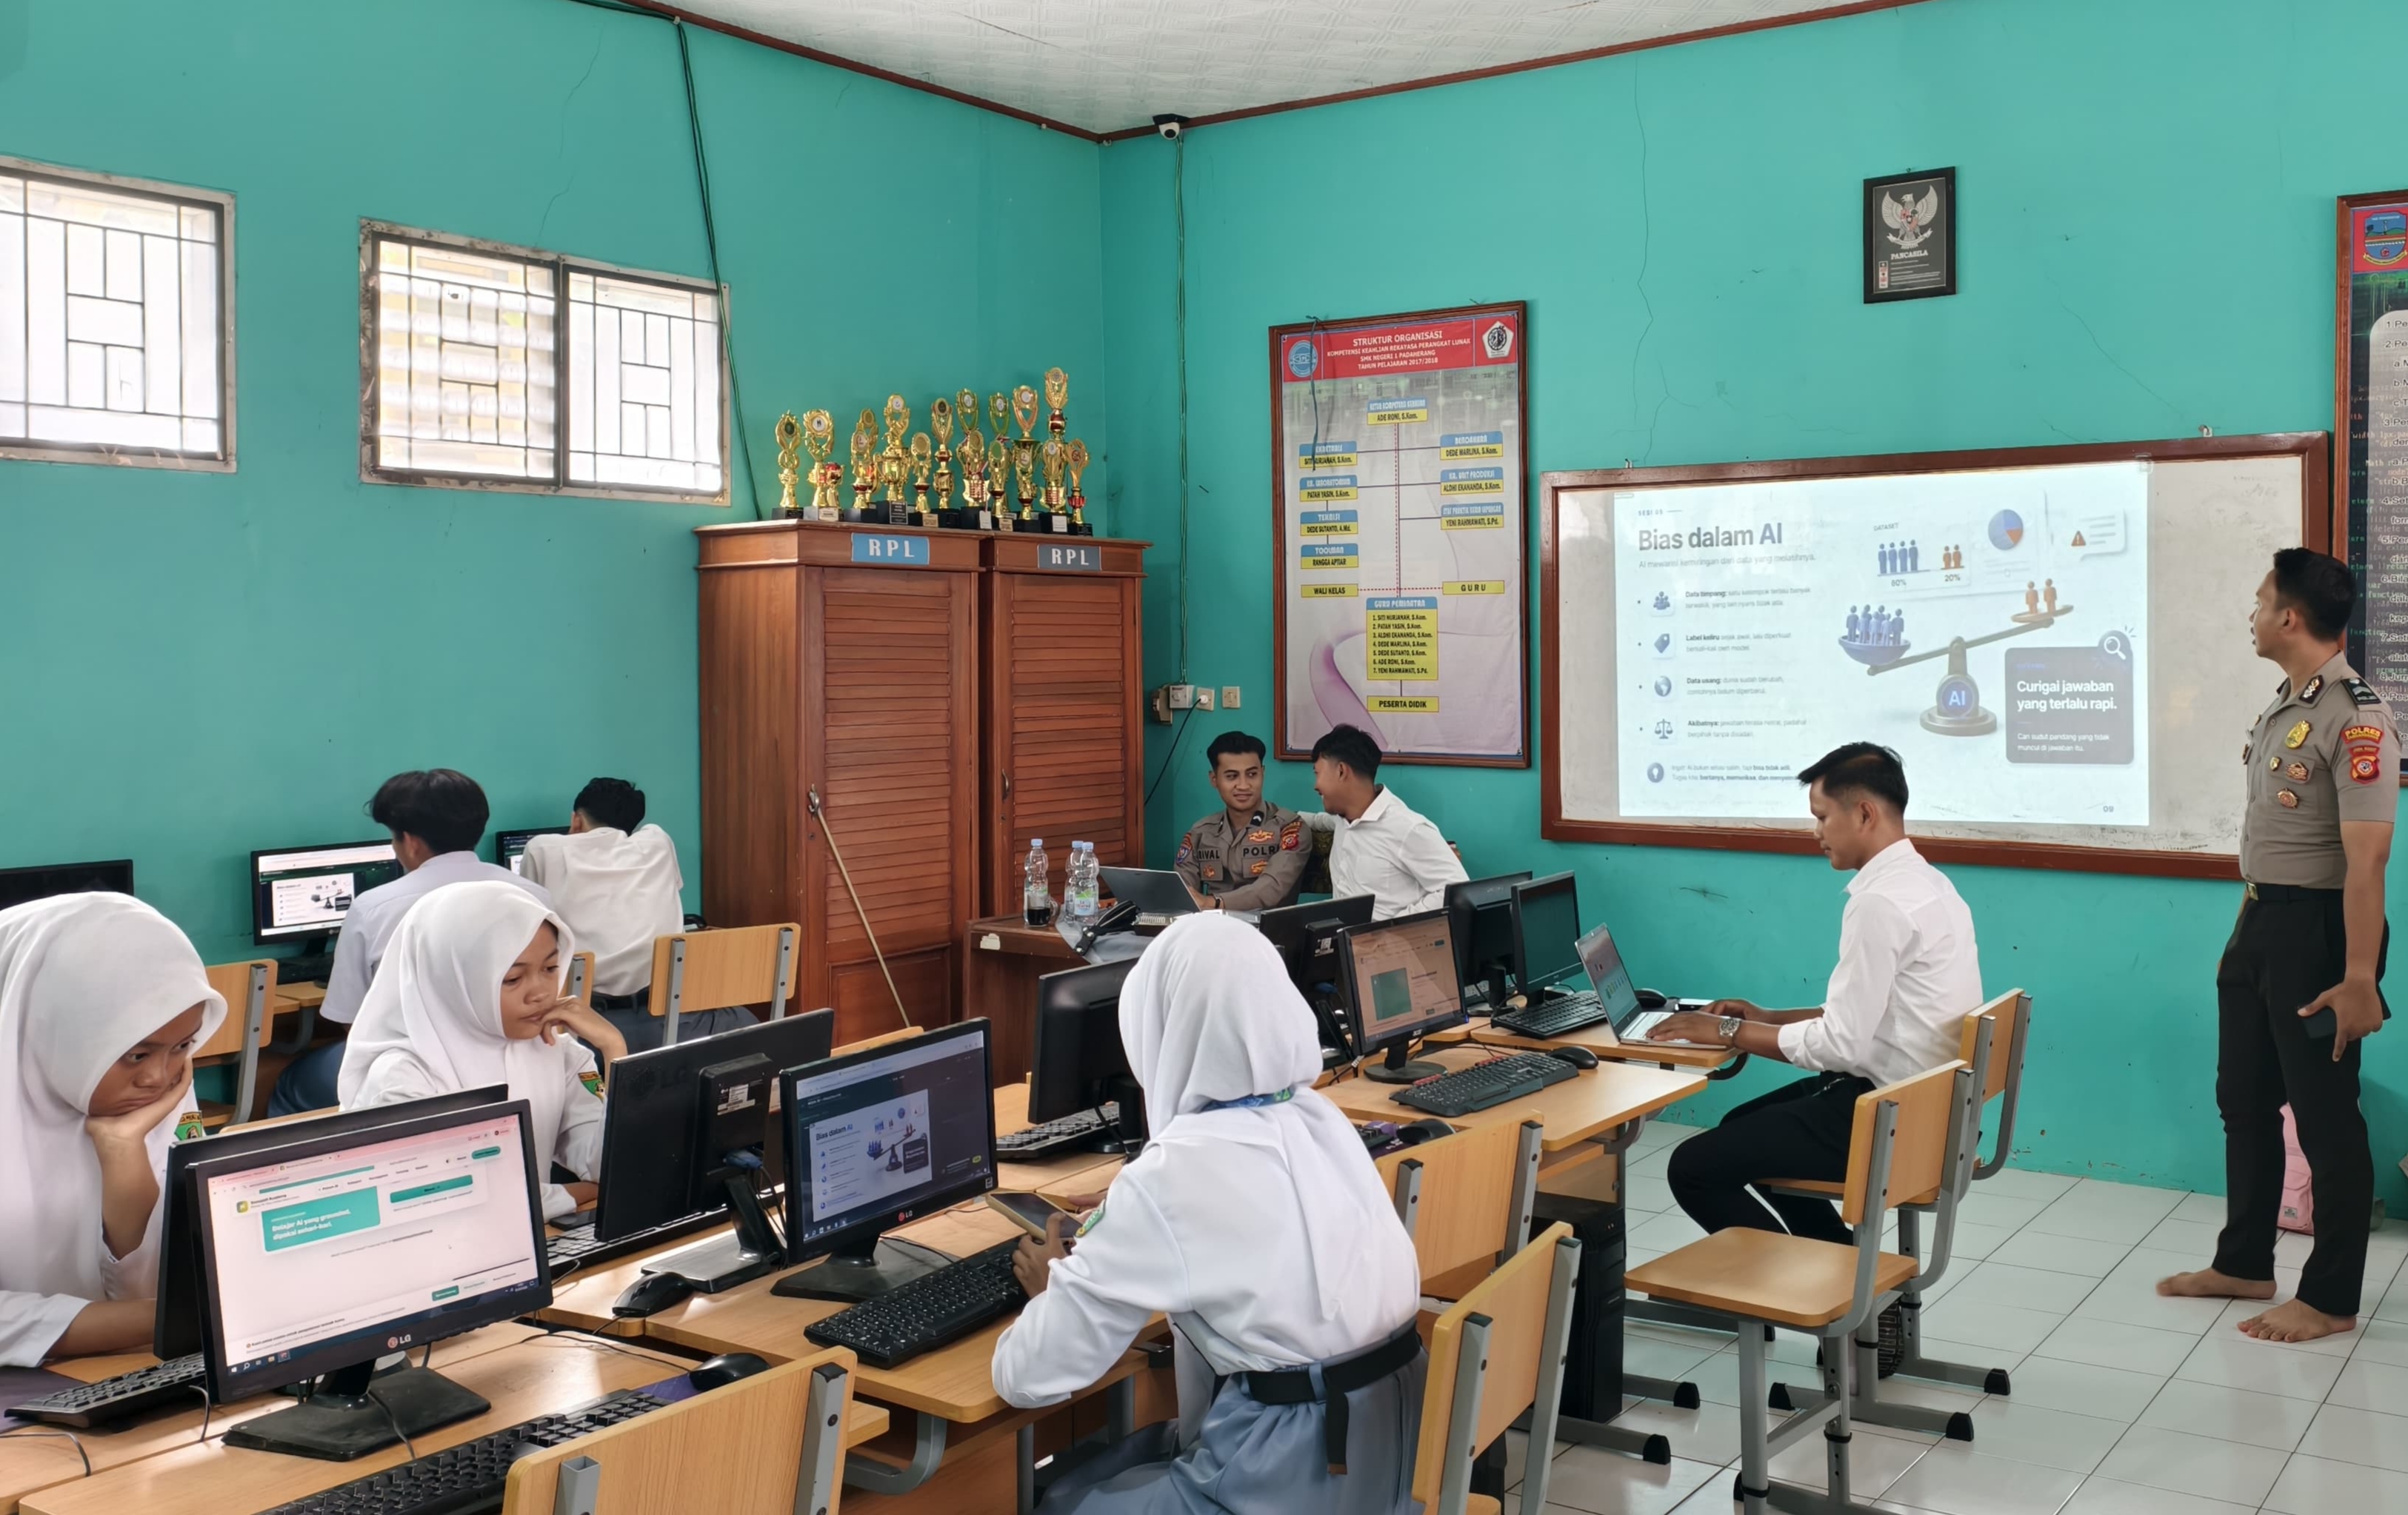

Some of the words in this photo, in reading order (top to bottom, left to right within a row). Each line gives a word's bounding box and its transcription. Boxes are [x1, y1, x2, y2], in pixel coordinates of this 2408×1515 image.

[1891, 250, 1928, 259] PANCASILA
[1353, 335, 1393, 346] STRUKTUR
[1395, 331, 1443, 343] ORGANISASI
[1327, 349, 1361, 357] KOMPETENSI
[1362, 346, 1389, 354] KEAHLIAN
[1390, 343, 1417, 352] REKAYASA
[1418, 341, 1450, 349] PERANGKAT
[1452, 338, 1470, 346] LUNAK
[1373, 353, 1393, 361] NEGERI
[1398, 350, 1435, 359] PADAHERANG
[1377, 360, 1407, 368] PELAJARAN
[1409, 358, 1438, 366] 2017/2018
[1388, 413, 1400, 421] RONI,
[1458, 447, 1481, 456] MARLINA,
[1481, 447, 1498, 455] S.Kom.
[1874, 523, 1898, 531] DATASET
[1639, 529, 1683, 551] Bias
[1688, 526, 1753, 548] dalam
[1759, 523, 1782, 544] AI
[869, 538, 915, 557] RPL
[1052, 548, 1089, 565] RPL
[2017, 680, 2060, 695] Curigai
[2061, 680, 2114, 695] jawaban
[1949, 690, 1965, 706] AI
[2017, 700, 2047, 712] yang
[2050, 698, 2087, 709] terlalu
[2090, 698, 2117, 712] rapi.
[2050, 733, 2077, 742] pandang
[2345, 727, 2381, 740] POLRES
[400, 1334, 412, 1344] LG
